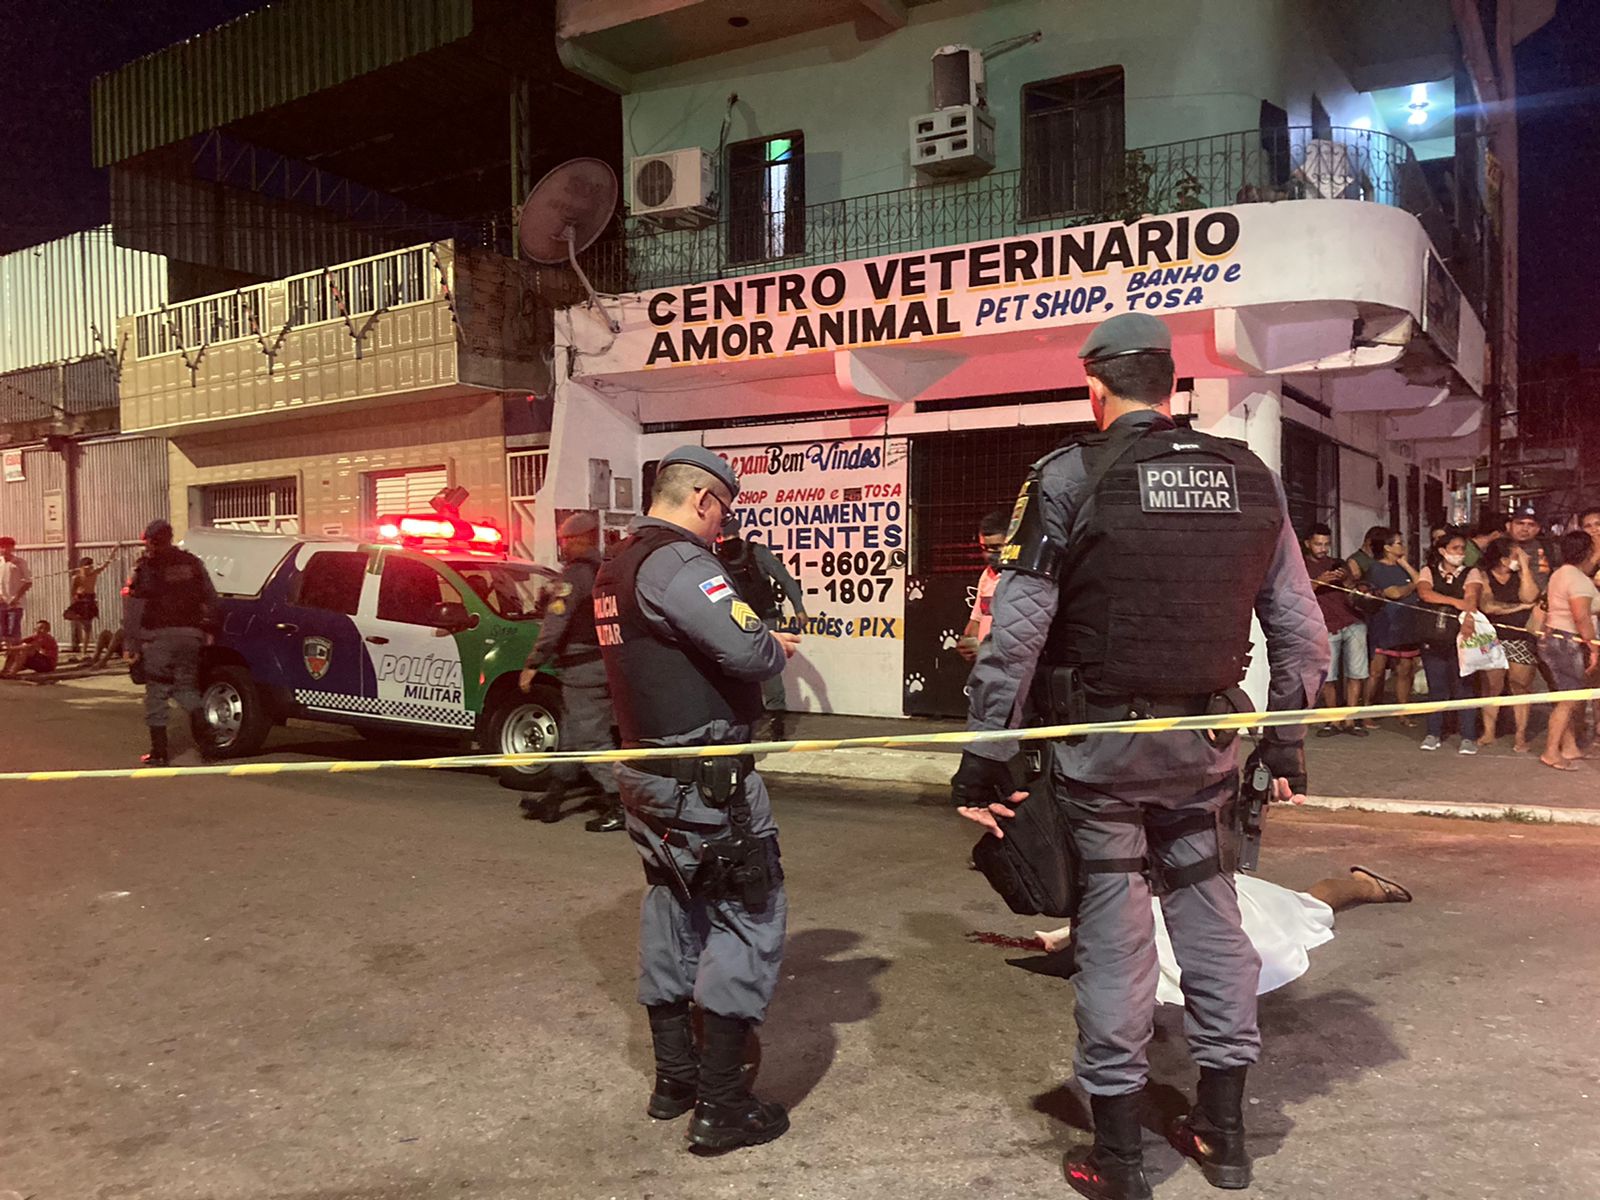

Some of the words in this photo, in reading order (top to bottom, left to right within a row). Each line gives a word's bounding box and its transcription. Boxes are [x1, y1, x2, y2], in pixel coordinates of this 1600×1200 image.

[647, 267, 846, 327] CENTRO
[864, 211, 1240, 301] VETERINÁRIO
[1126, 263, 1219, 293] BANHO
[1223, 263, 1242, 283] e
[975, 293, 1030, 327] PET
[1032, 285, 1114, 320] SHOP,
[1126, 286, 1204, 311] TOSA
[645, 319, 774, 366] AMOR
[785, 297, 961, 352] ANIMAL
[717, 451, 769, 479] ejam
[765, 445, 805, 475] Bem
[805, 441, 882, 472] Vindos
[1146, 466, 1230, 488] POLÍCIA
[736, 489, 769, 505] SHOP
[775, 487, 826, 504] BANHO
[829, 488, 840, 500] e
[863, 482, 902, 499] TOSA
[1149, 490, 1231, 508] MILITAR
[745, 523, 903, 552] CLIENTES
[775, 550, 887, 577] 1-8602
[772, 577, 894, 604] 8-1807
[845, 620, 855, 636] e
[859, 616, 896, 638] PIX
[377, 653, 463, 690] POLÍCIA
[403, 684, 462, 704] MILITAR
